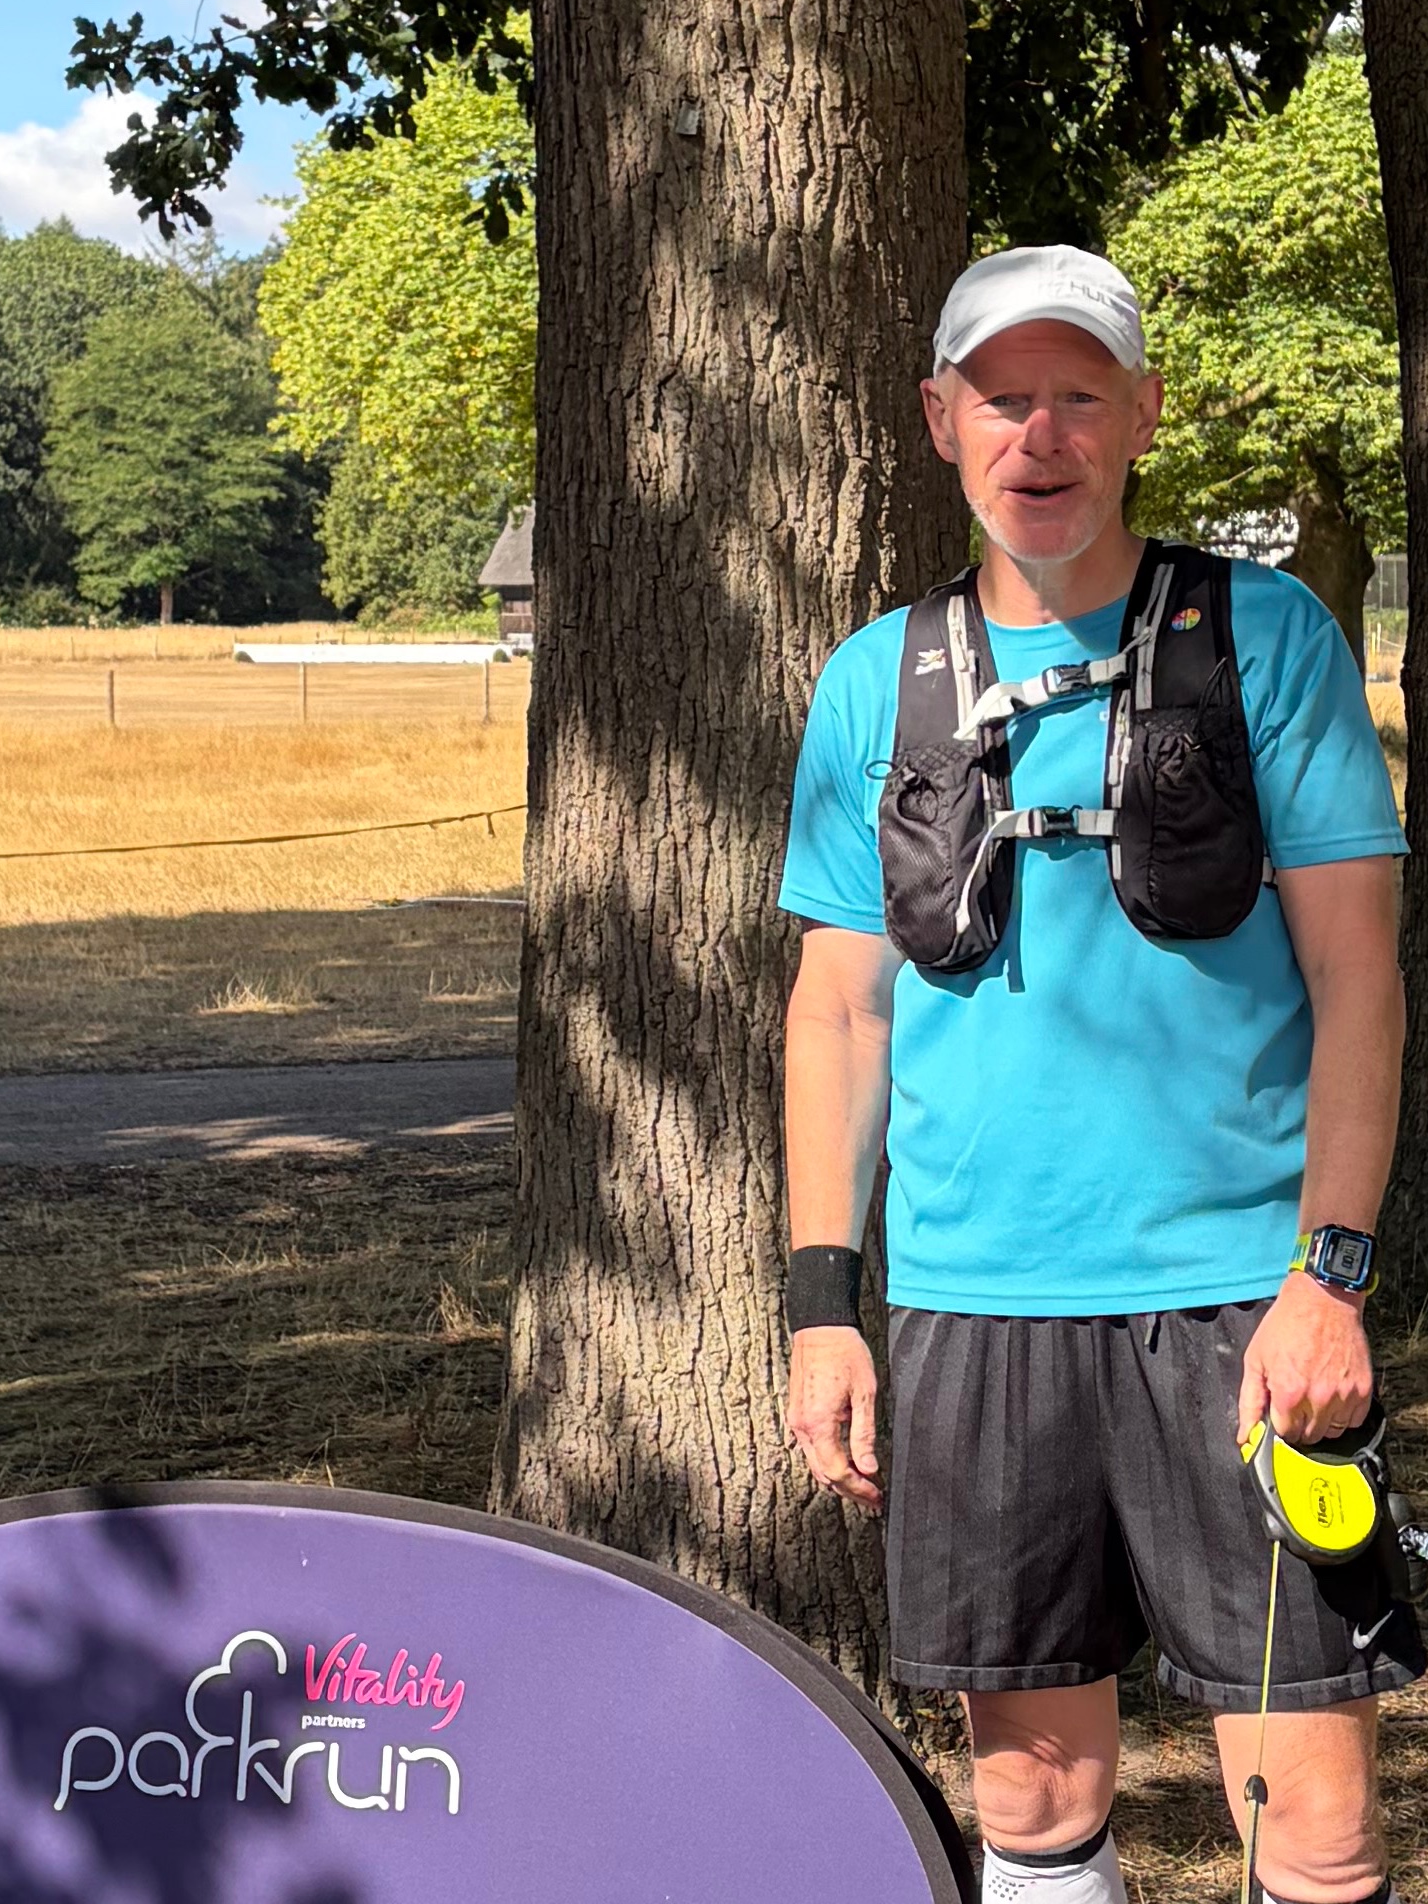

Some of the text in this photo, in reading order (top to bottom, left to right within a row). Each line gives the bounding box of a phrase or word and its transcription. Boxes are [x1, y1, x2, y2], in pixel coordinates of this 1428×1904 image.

[54, 1630, 461, 1814] parkrun
[301, 1713, 367, 1730] partners
[305, 1633, 466, 1731] Vitality
